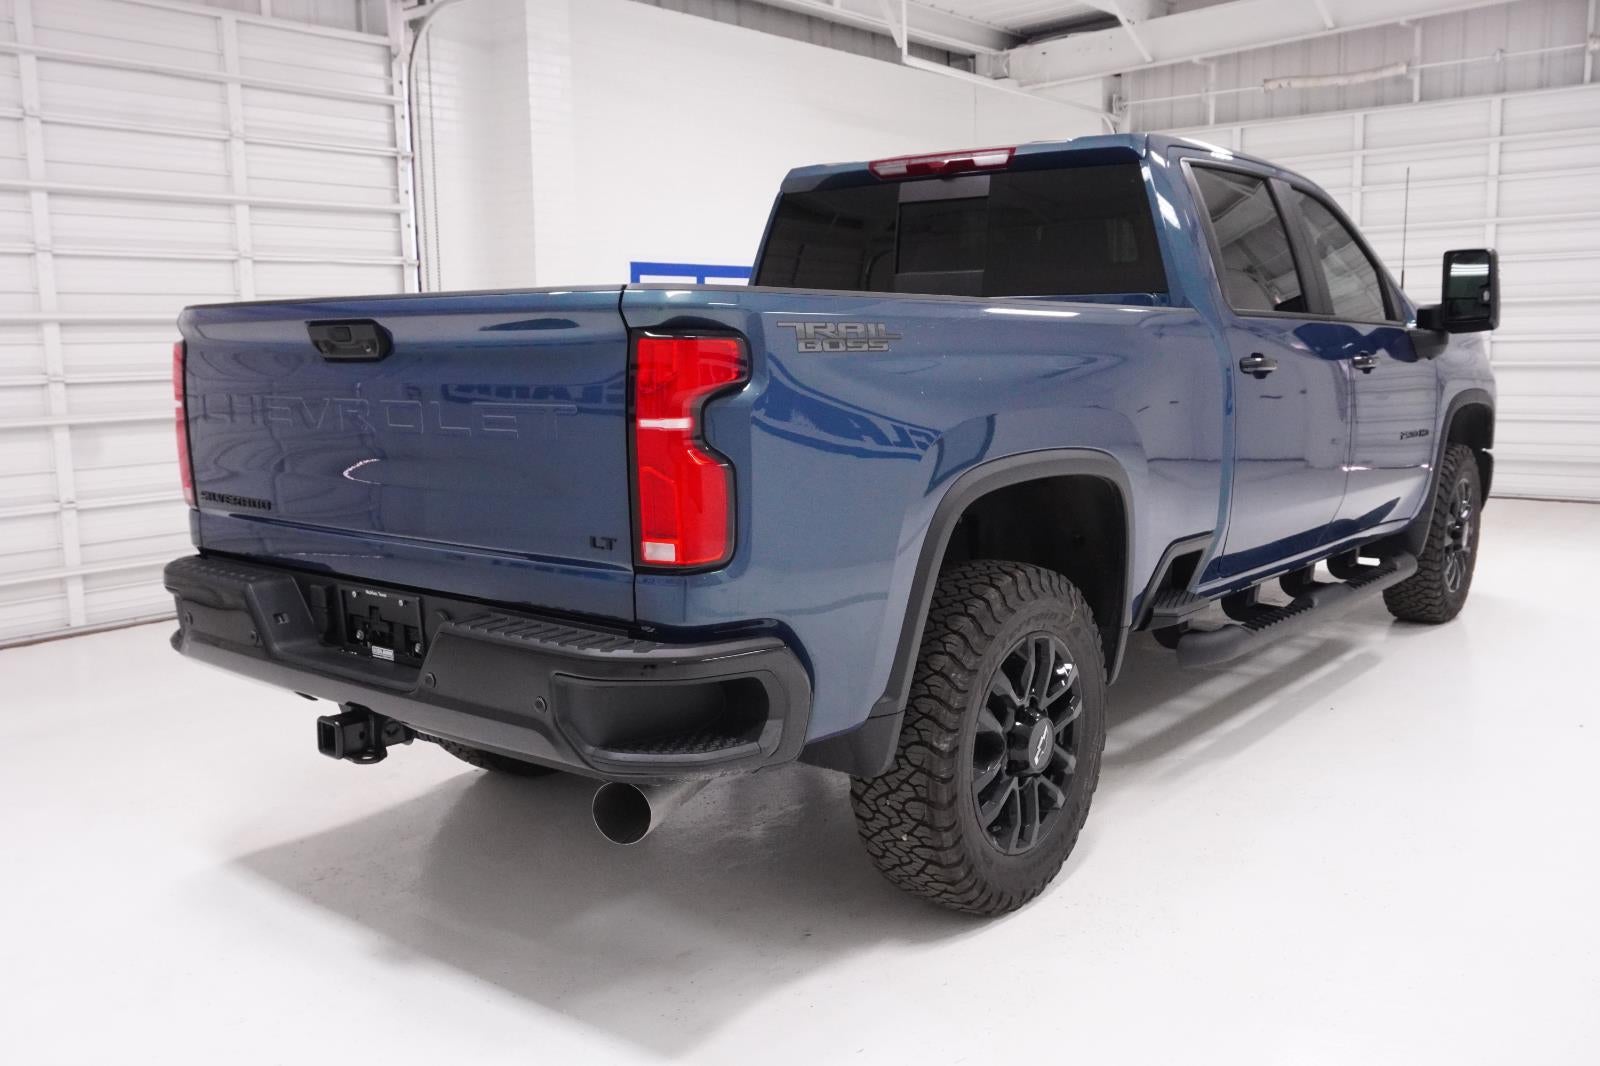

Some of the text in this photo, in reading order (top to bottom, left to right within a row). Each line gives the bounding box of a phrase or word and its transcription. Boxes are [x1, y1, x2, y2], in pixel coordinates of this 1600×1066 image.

[777, 321, 902, 340] TRAIL
[797, 339, 890, 353] BOSS
[590, 535, 618, 551] LT
